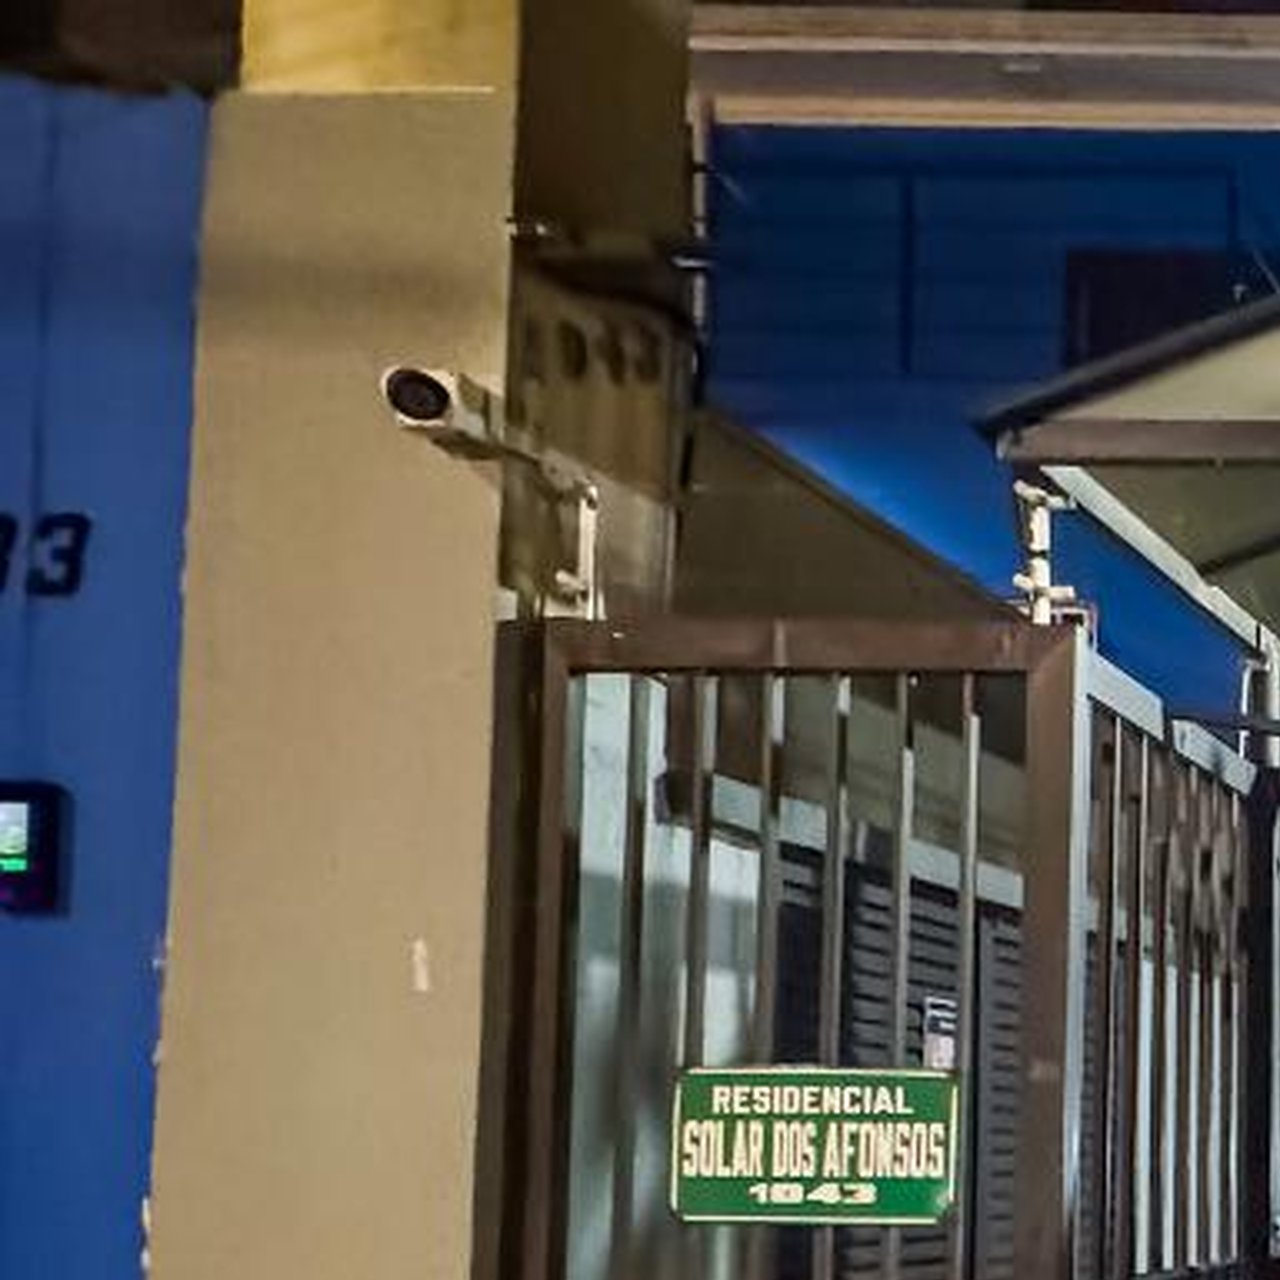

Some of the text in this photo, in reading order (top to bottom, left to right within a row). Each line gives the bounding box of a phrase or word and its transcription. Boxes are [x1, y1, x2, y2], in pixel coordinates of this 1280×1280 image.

[0, 512, 93, 597] 3
[712, 1085, 914, 1115] RESIDENCIAL
[682, 1119, 946, 1179] SOLAR DOS AFONSOS
